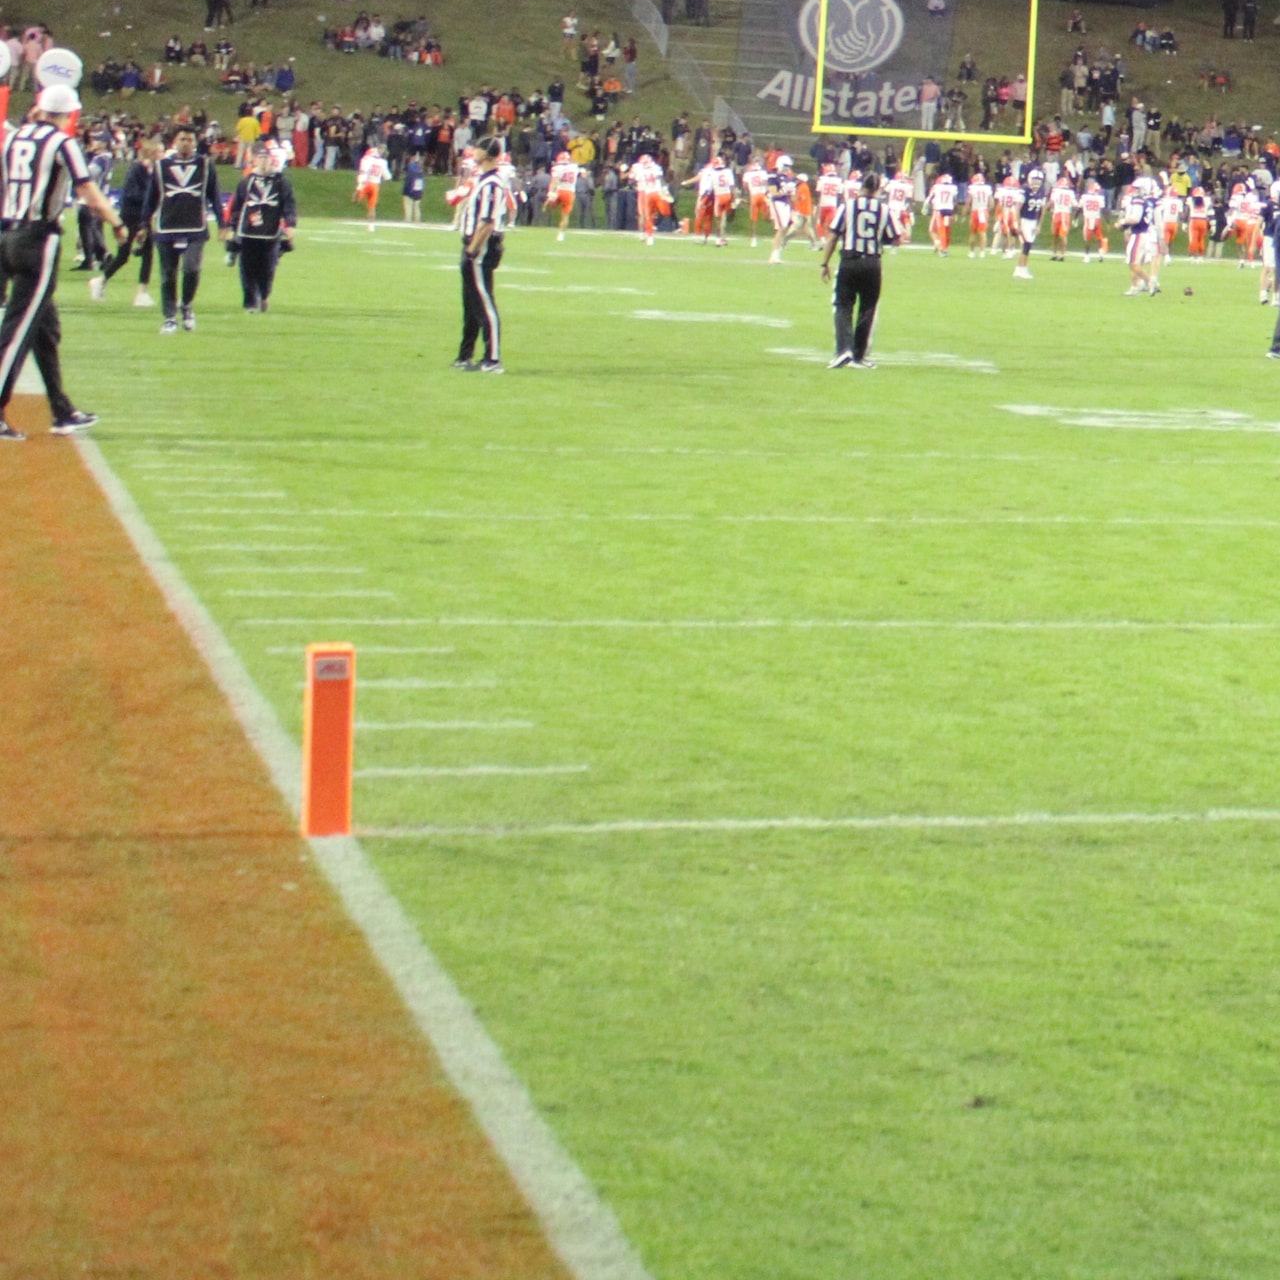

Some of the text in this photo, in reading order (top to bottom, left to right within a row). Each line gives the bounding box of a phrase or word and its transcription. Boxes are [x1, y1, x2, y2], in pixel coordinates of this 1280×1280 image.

[45, 64, 74, 78] ACC
[756, 70, 918, 118] Allstate
[9, 140, 36, 180] R
[856, 211, 876, 238] C
